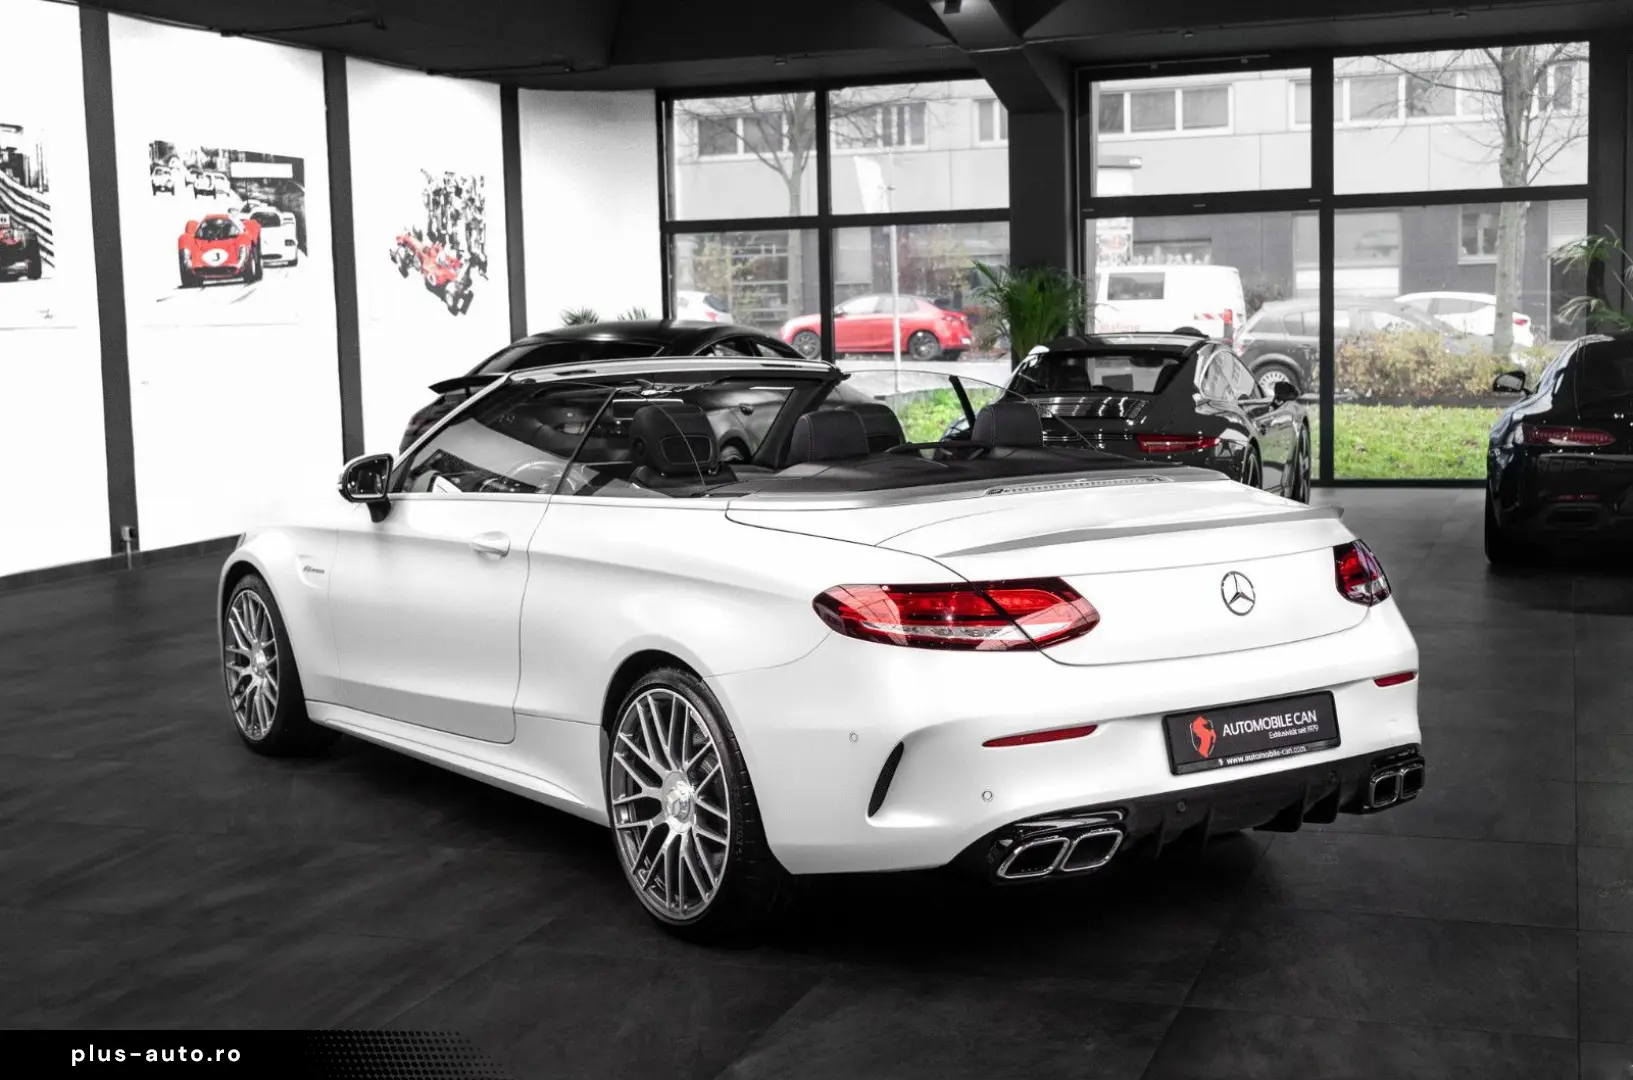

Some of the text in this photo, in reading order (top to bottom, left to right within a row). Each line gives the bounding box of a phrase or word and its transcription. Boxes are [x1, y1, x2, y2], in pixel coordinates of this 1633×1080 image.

[1222, 710, 1318, 737] AUTOMOBILE CAN
[1226, 746, 1306, 765] www.automobile-can.com
